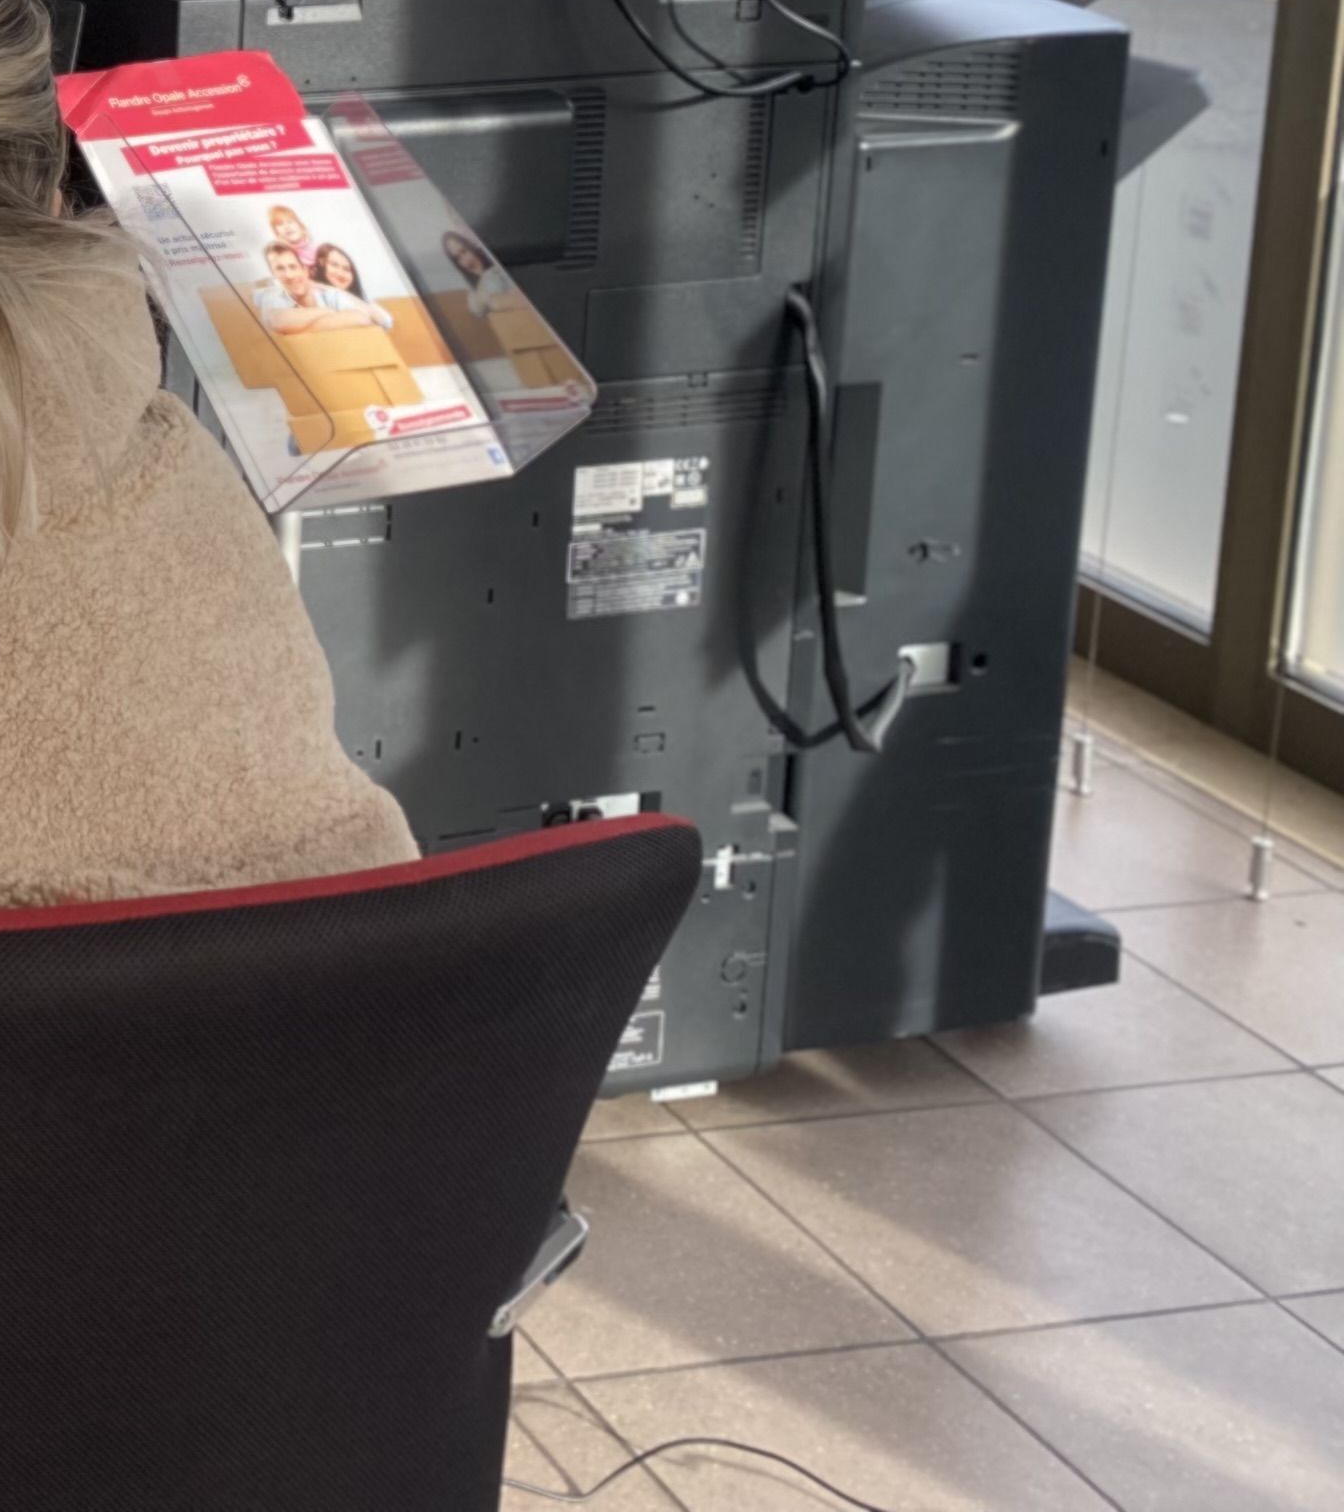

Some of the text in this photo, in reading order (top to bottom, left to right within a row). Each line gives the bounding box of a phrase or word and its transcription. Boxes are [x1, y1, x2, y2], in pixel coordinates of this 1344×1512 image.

[109, 84, 242, 108] Flandre Opale Accession
[149, 123, 287, 156] Devenir propriétaire ?
[174, 149, 224, 166] Pourquoi
[224, 146, 245, 159] pas
[245, 142, 270, 154] vous
